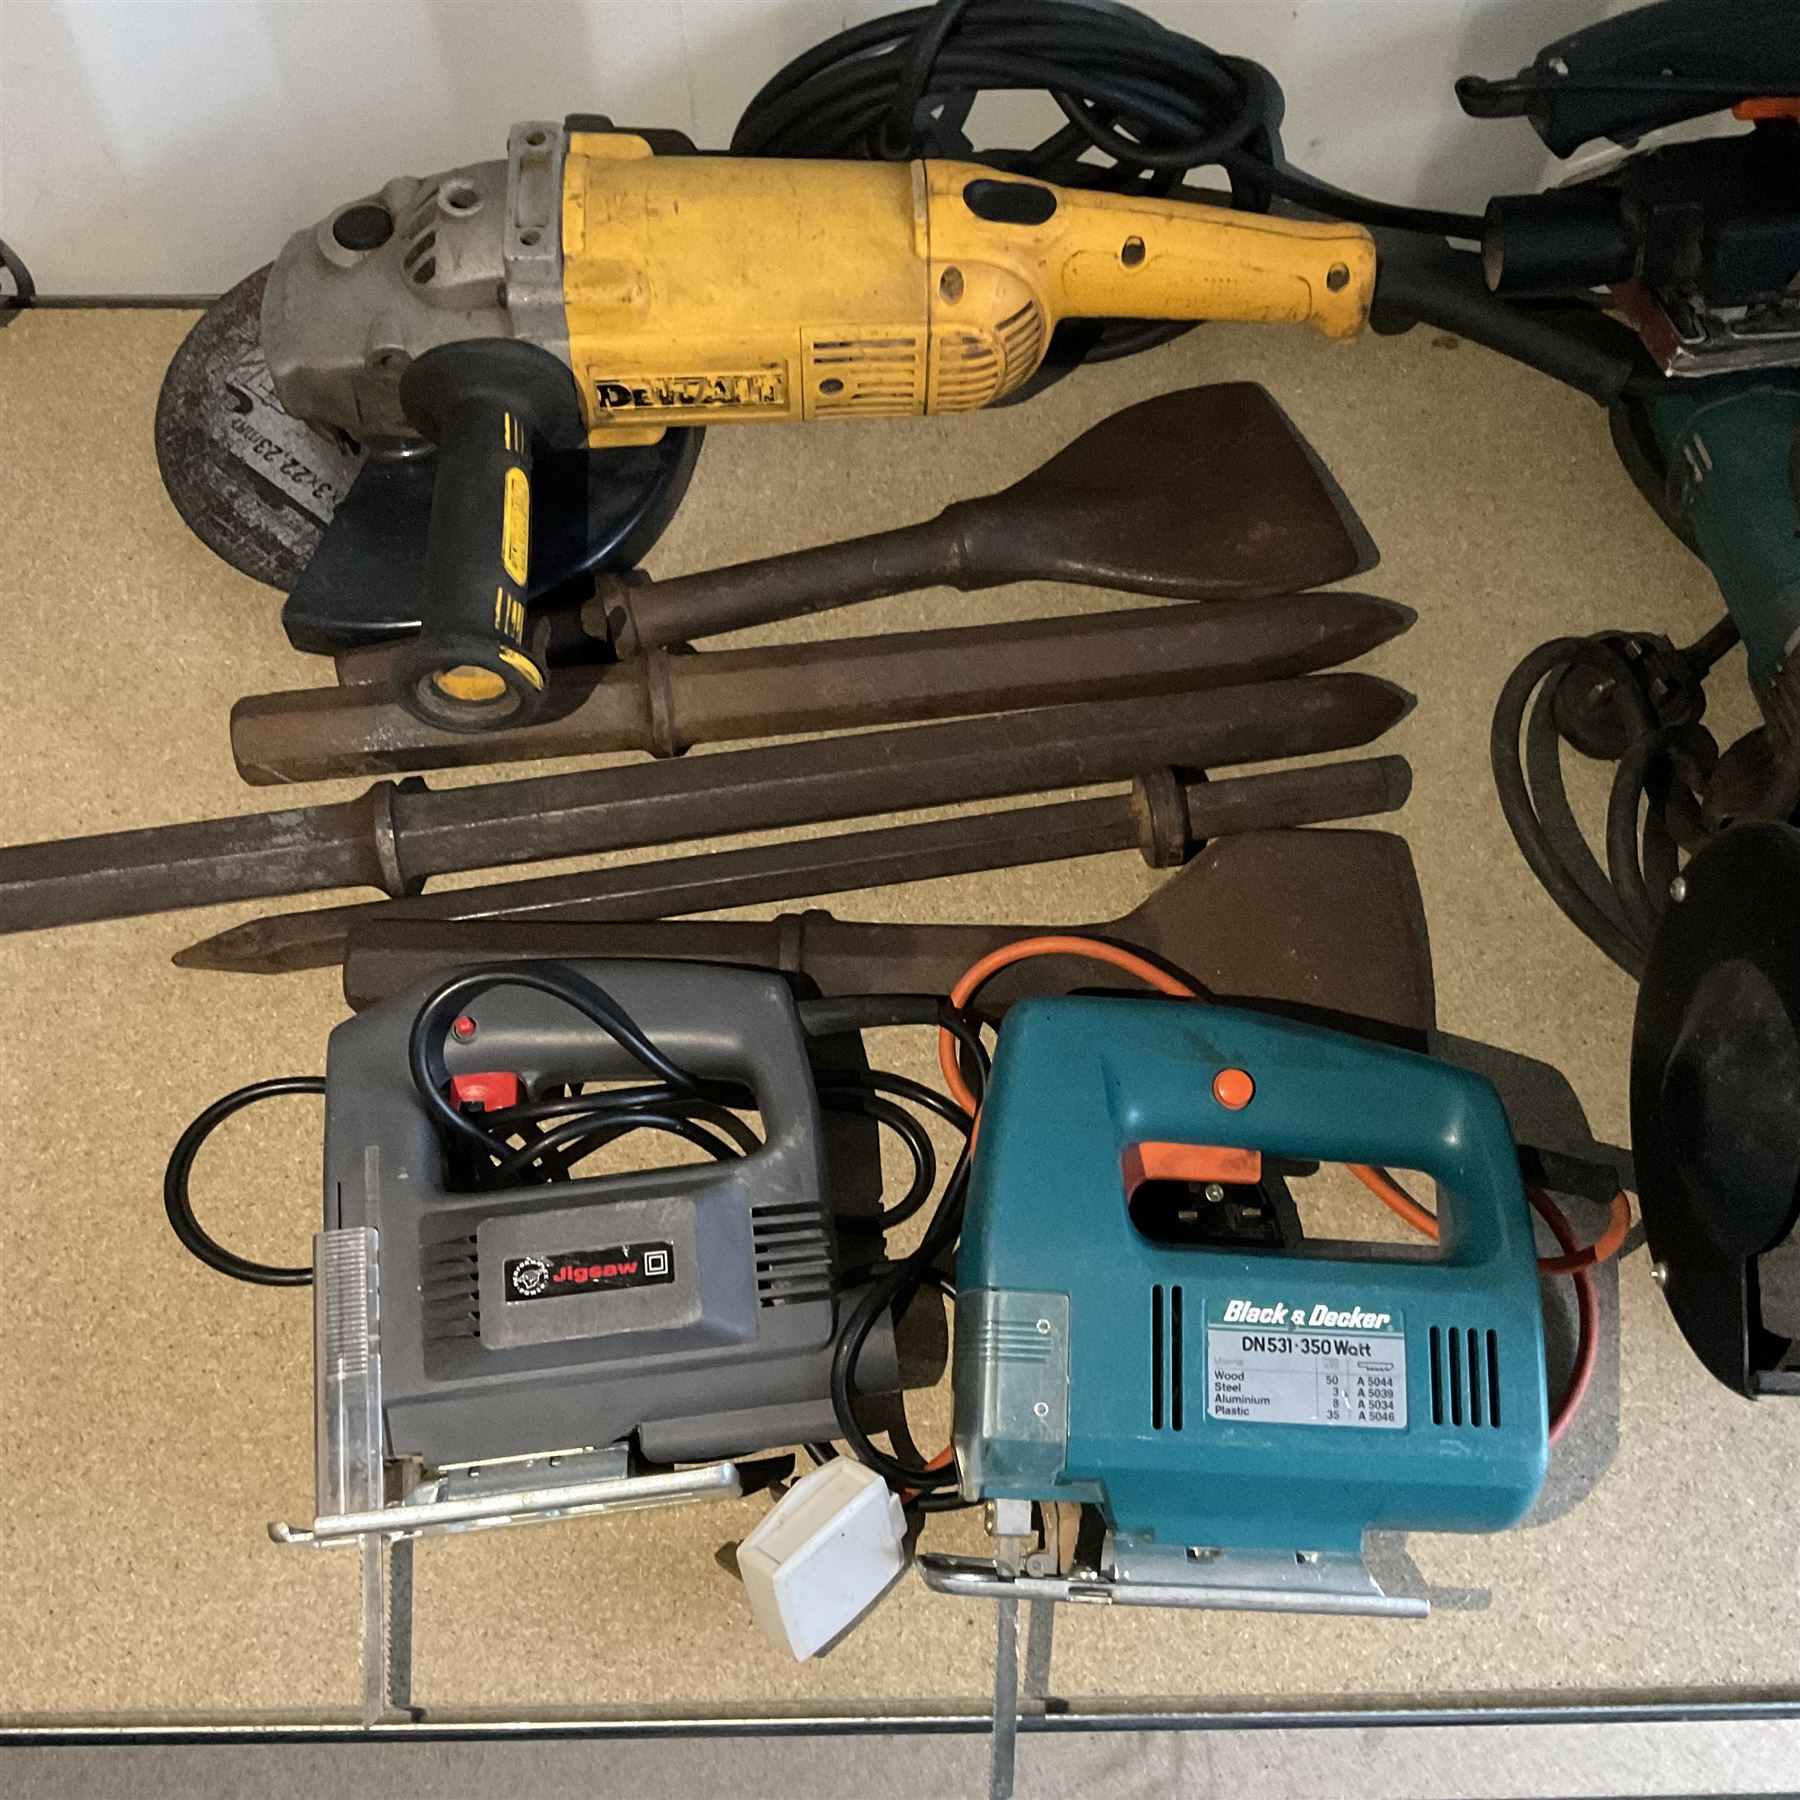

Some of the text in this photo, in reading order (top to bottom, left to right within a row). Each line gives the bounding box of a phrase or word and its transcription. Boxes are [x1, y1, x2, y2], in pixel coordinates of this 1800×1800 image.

[553, 1261, 638, 1283] Jigsaw
[1223, 1300, 1391, 1329] Black & Decker
[1334, 1339, 1372, 1357] Watt
[1214, 1371, 1245, 1381] Wood
[1326, 1375, 1339, 1385] 50
[1368, 1377, 1393, 1387] 5044
[1214, 1382, 1242, 1392] Steel
[1333, 1387, 1339, 1397] 3
[1368, 1389, 1394, 1399] 5039
[1215, 1394, 1271, 1405] Aluminium
[1333, 1399, 1339, 1408] 8
[1368, 1400, 1394, 1410] 5034
[1215, 1406, 1250, 1416] Plastic
[1326, 1411, 1340, 1420] 35
[1369, 1412, 1395, 1422] 5046
